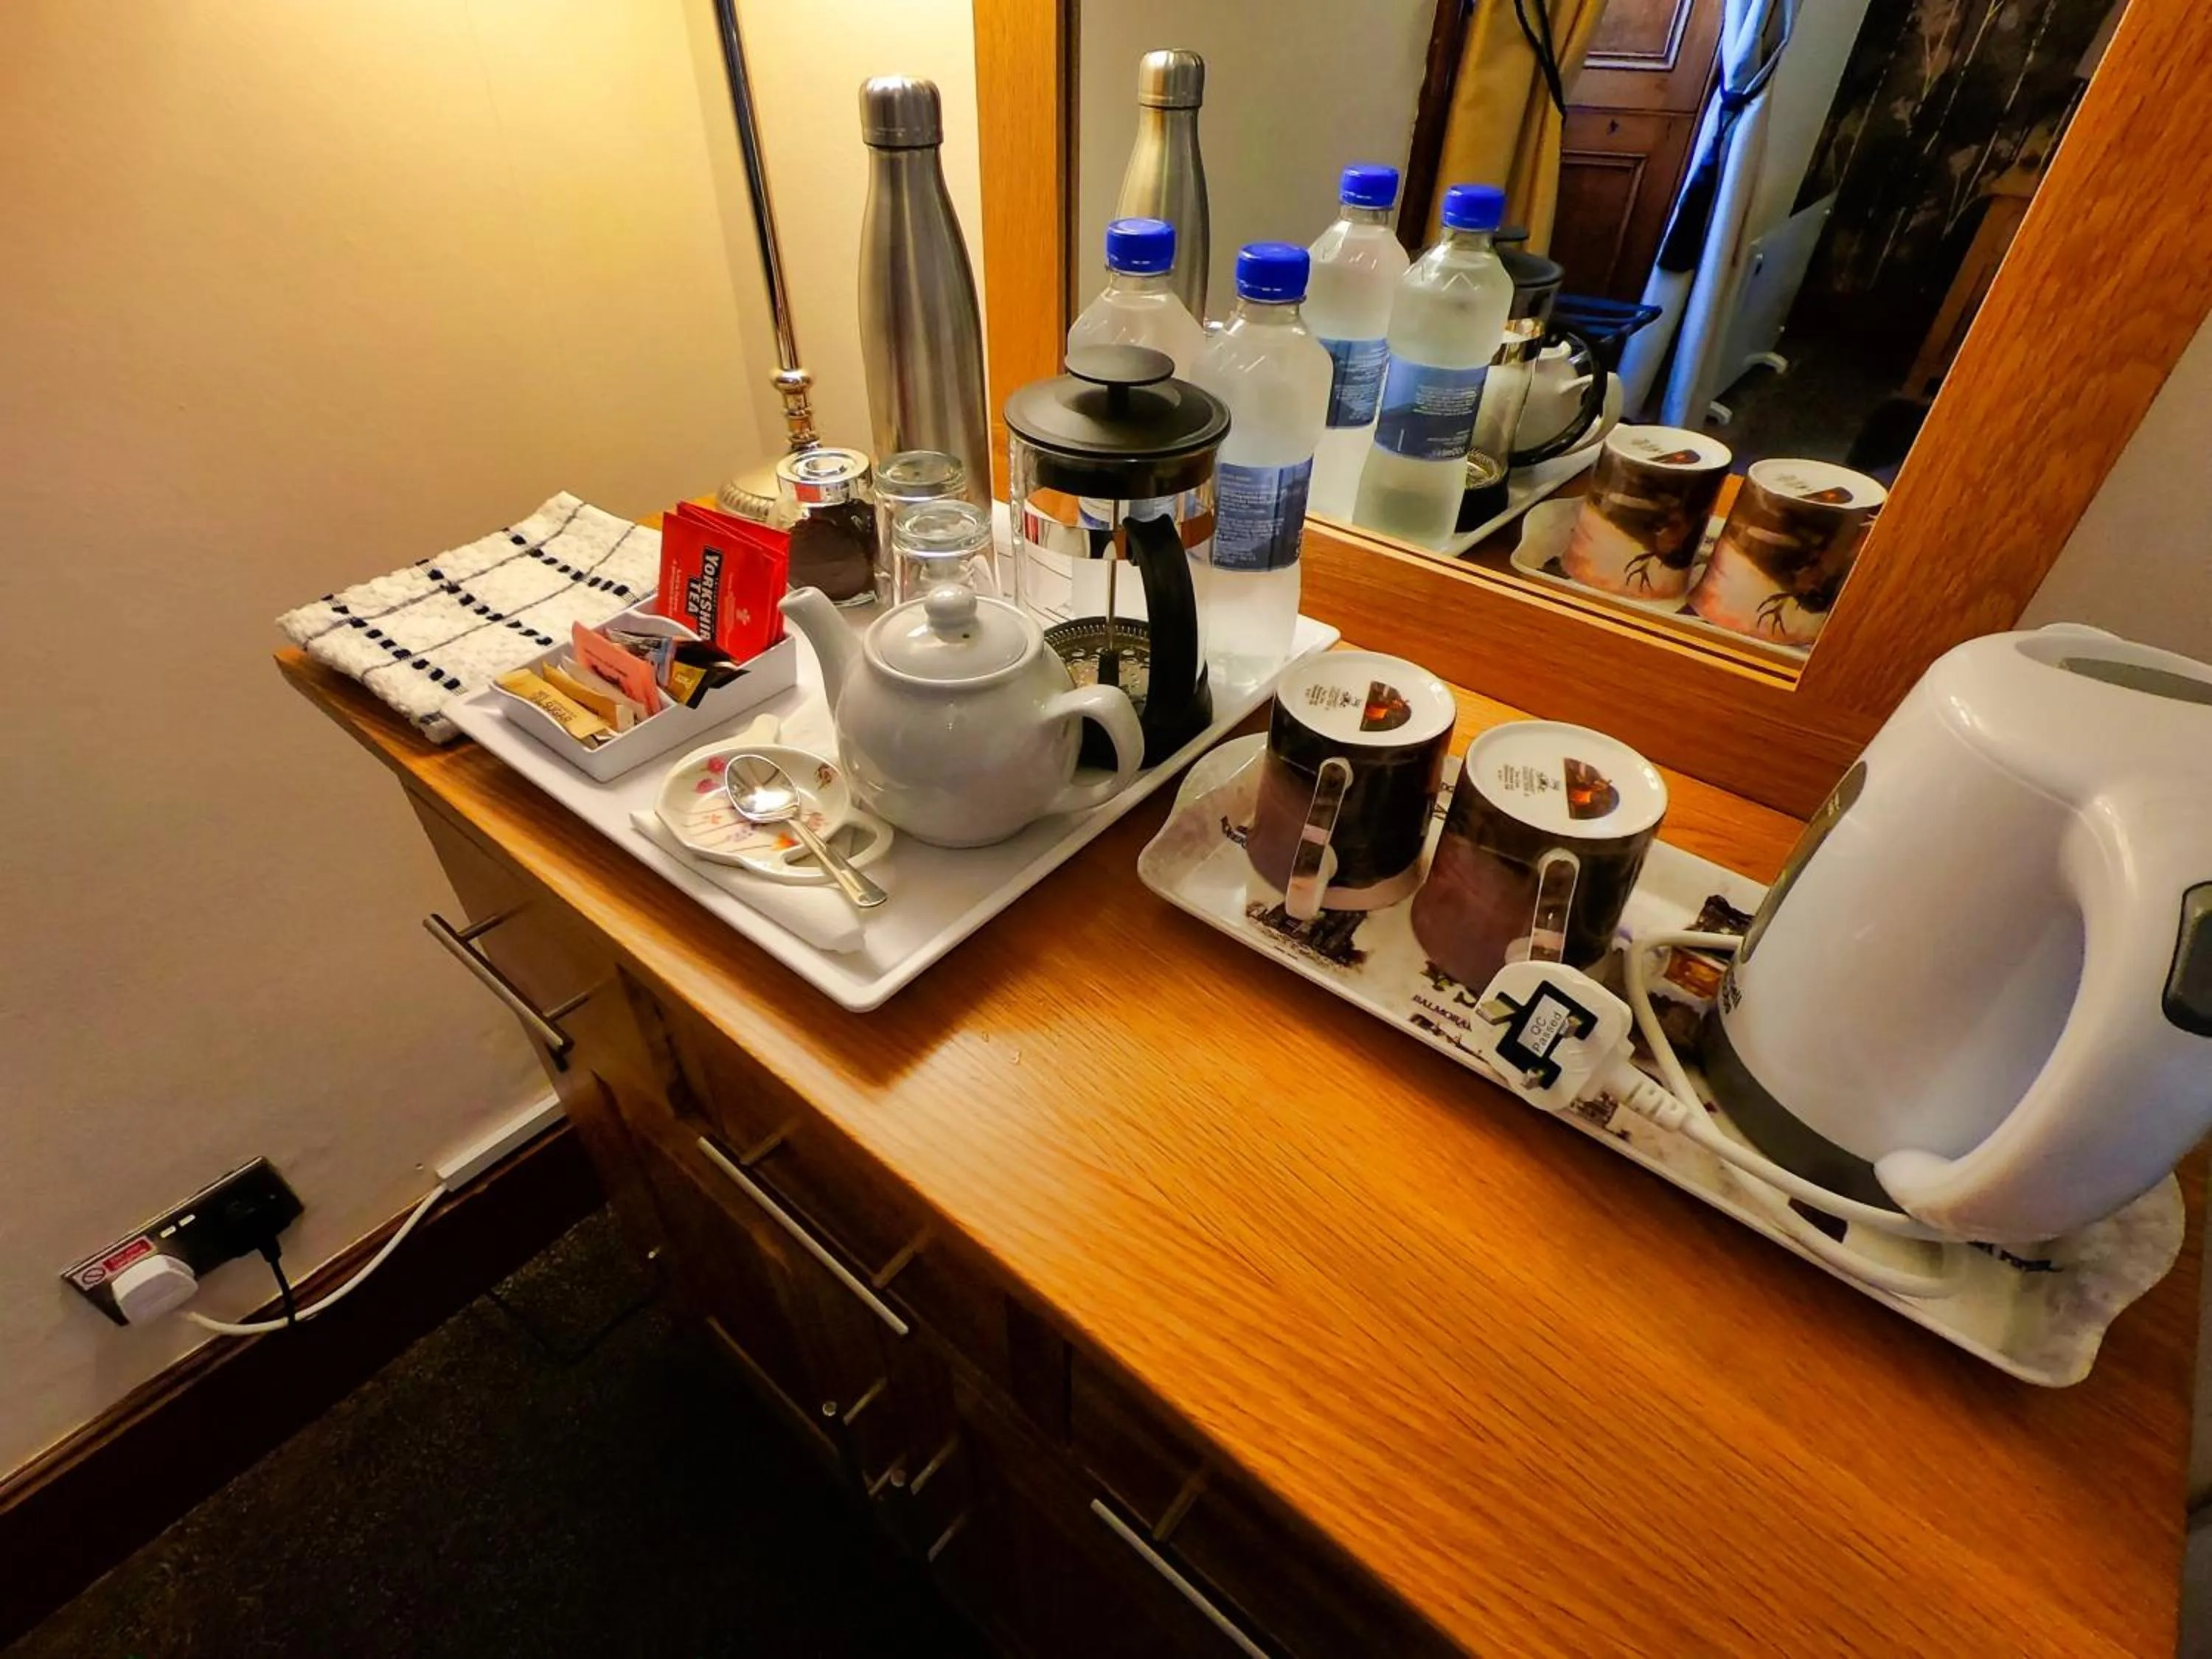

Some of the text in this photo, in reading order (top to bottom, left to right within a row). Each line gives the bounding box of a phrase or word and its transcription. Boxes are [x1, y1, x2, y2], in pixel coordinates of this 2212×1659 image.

[688, 581, 701, 613] TEA
[698, 554, 720, 640] YORKSHIR
[1412, 994, 1472, 1032] BALMORAL
[1530, 1016, 1546, 1035] QC
[1532, 1010, 1562, 1052] Passed
